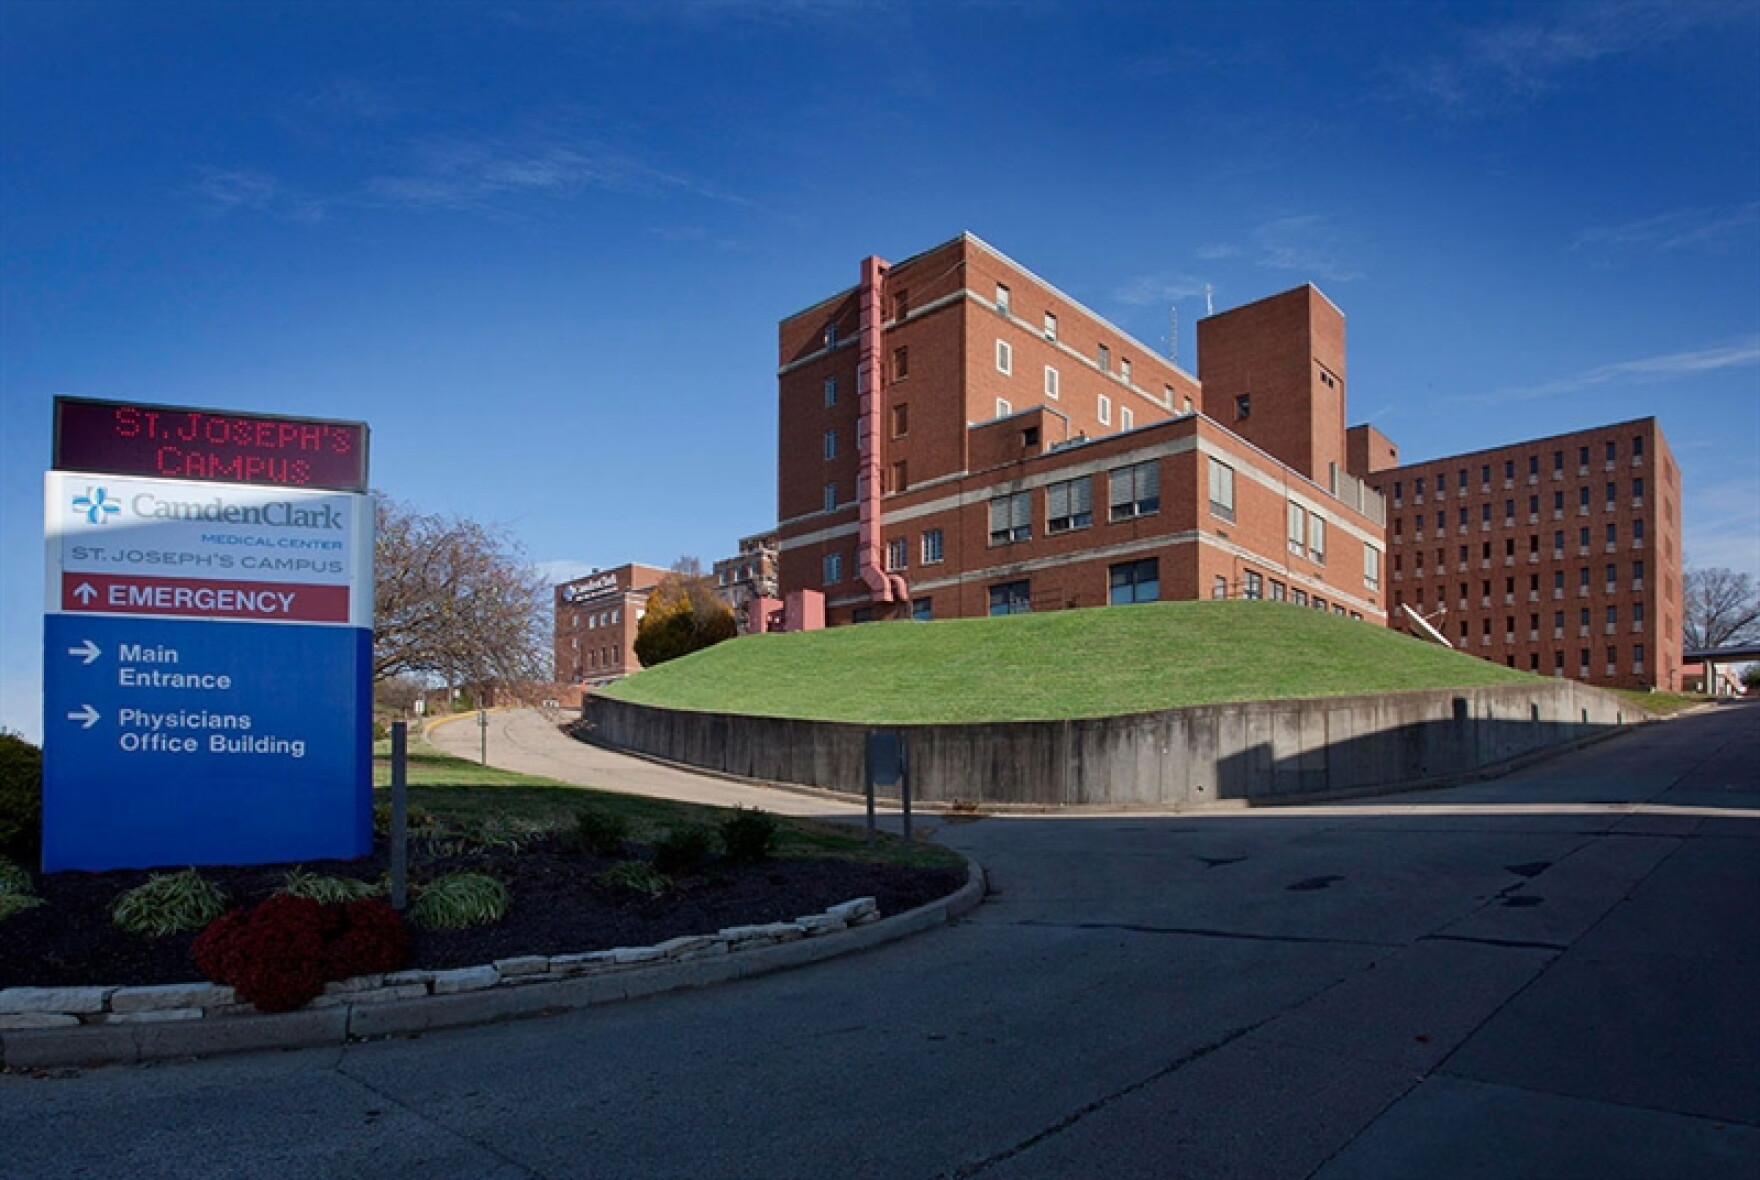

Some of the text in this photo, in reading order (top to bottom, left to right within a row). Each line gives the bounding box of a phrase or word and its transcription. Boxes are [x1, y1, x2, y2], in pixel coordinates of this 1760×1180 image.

[132, 492, 343, 530] CamdenClark
[201, 534, 343, 550] MEDICAL CENTER
[71, 546, 343, 574] ST. JOSEPH'S CAMPUS
[108, 585, 296, 613] EMERGENCY
[119, 644, 178, 663] Main
[119, 668, 232, 690] Entrance
[119, 709, 252, 731] Physicians
[120, 733, 305, 758] Office Building
